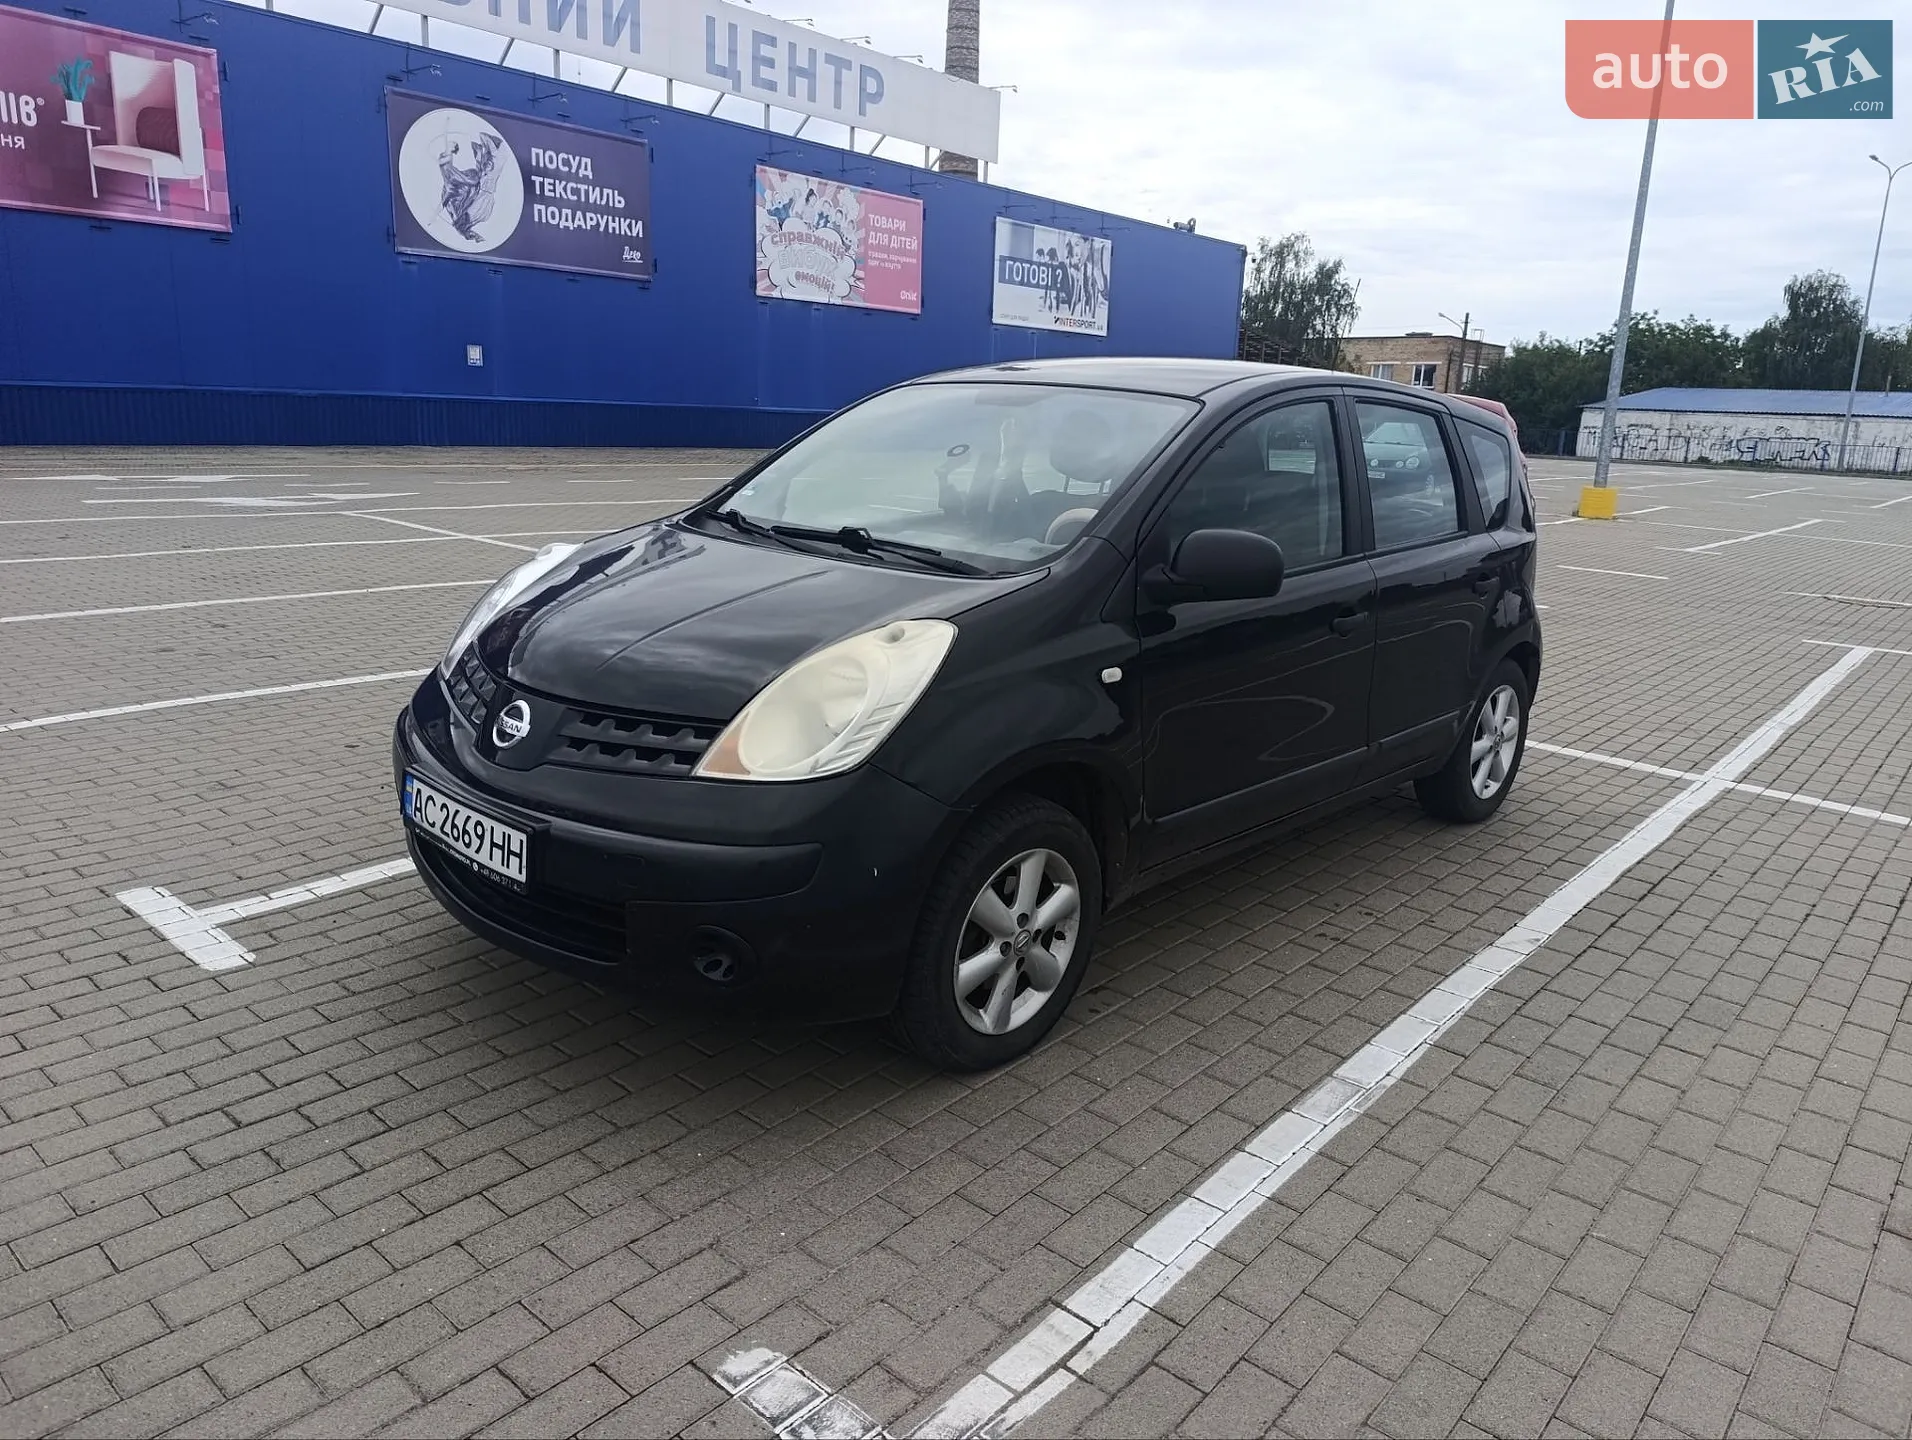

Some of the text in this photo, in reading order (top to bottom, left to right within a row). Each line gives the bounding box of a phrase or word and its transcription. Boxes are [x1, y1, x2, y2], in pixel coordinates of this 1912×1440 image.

[706, 15, 885, 117] ЦЕНТР
[531, 147, 593, 179] ПОСУД
[531, 175, 625, 208] ТЕКСТИЛЬ
[533, 204, 643, 238] ПОДАРУНКИ
[868, 213, 906, 232] ТОВАРИ
[868, 231, 918, 251] ДЛЯ ДІТЕЙ
[1005, 260, 1052, 287] ГОТОВІ
[413, 787, 437, 829] AC
[439, 802, 486, 855] 2669
[489, 824, 524, 876] HH
